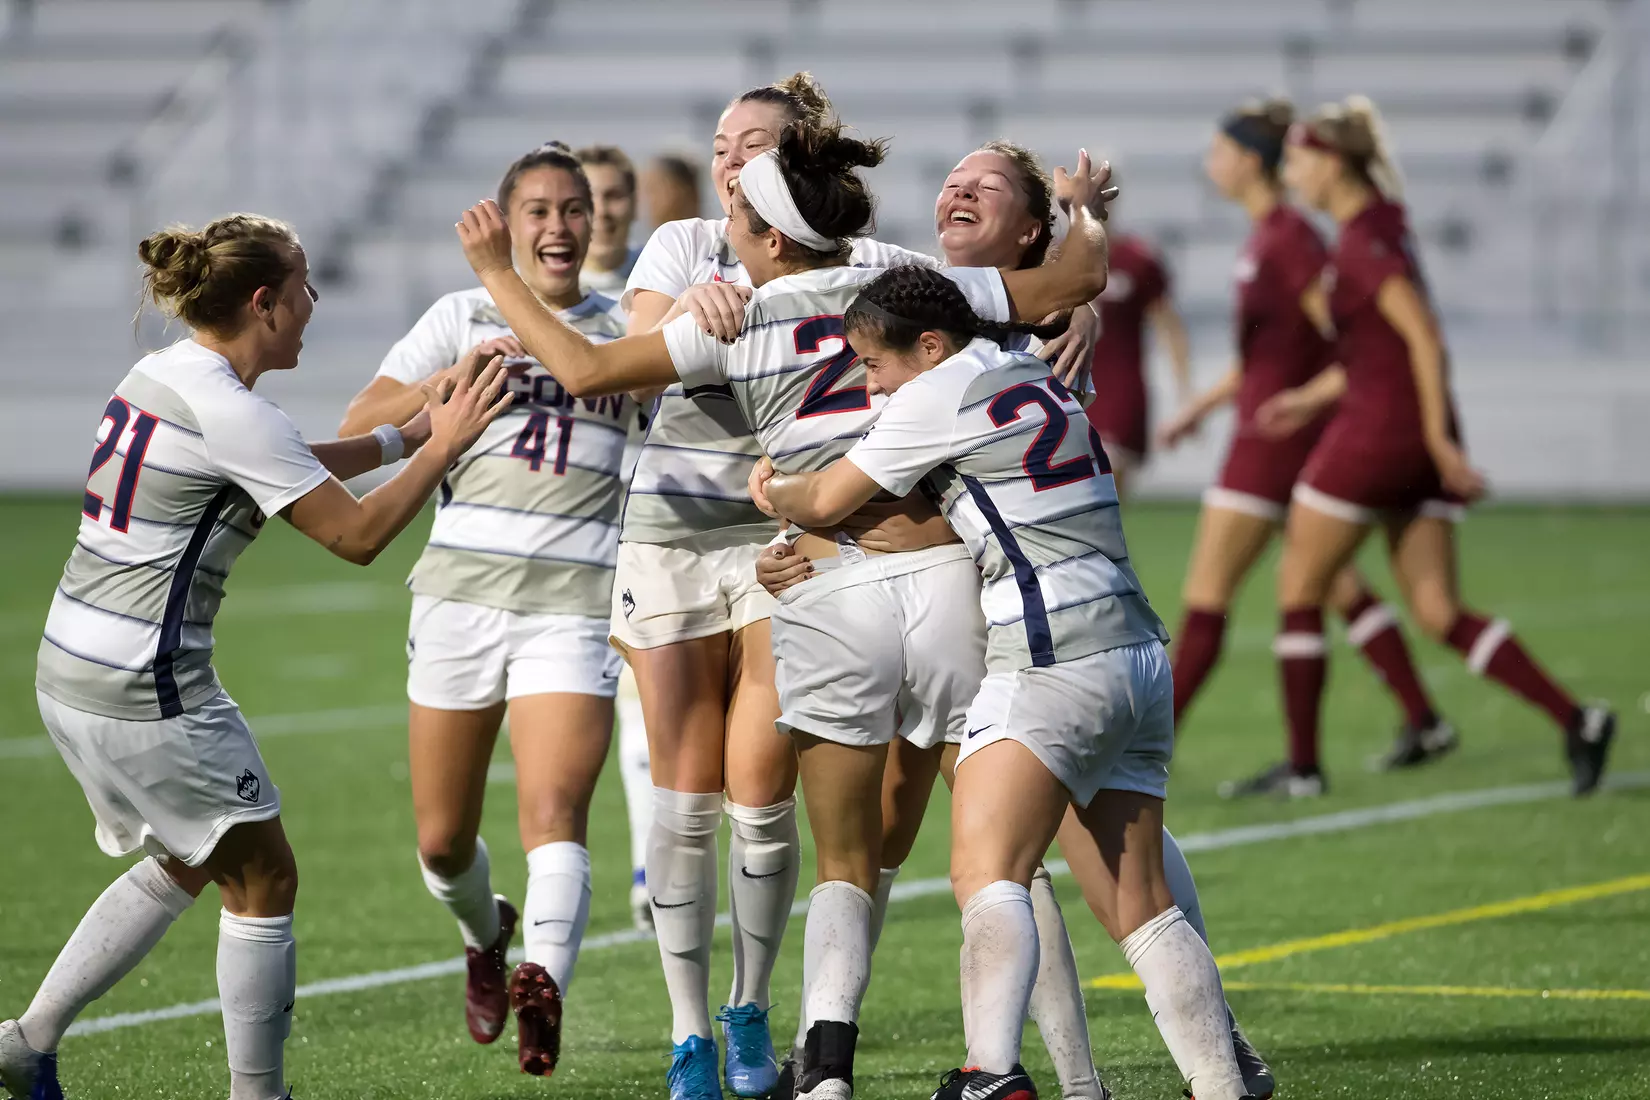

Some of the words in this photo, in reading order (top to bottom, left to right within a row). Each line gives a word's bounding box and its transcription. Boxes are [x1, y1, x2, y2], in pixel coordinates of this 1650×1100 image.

[488, 373, 623, 419] CON
[83, 396, 159, 534] 21
[510, 413, 575, 476] 41
